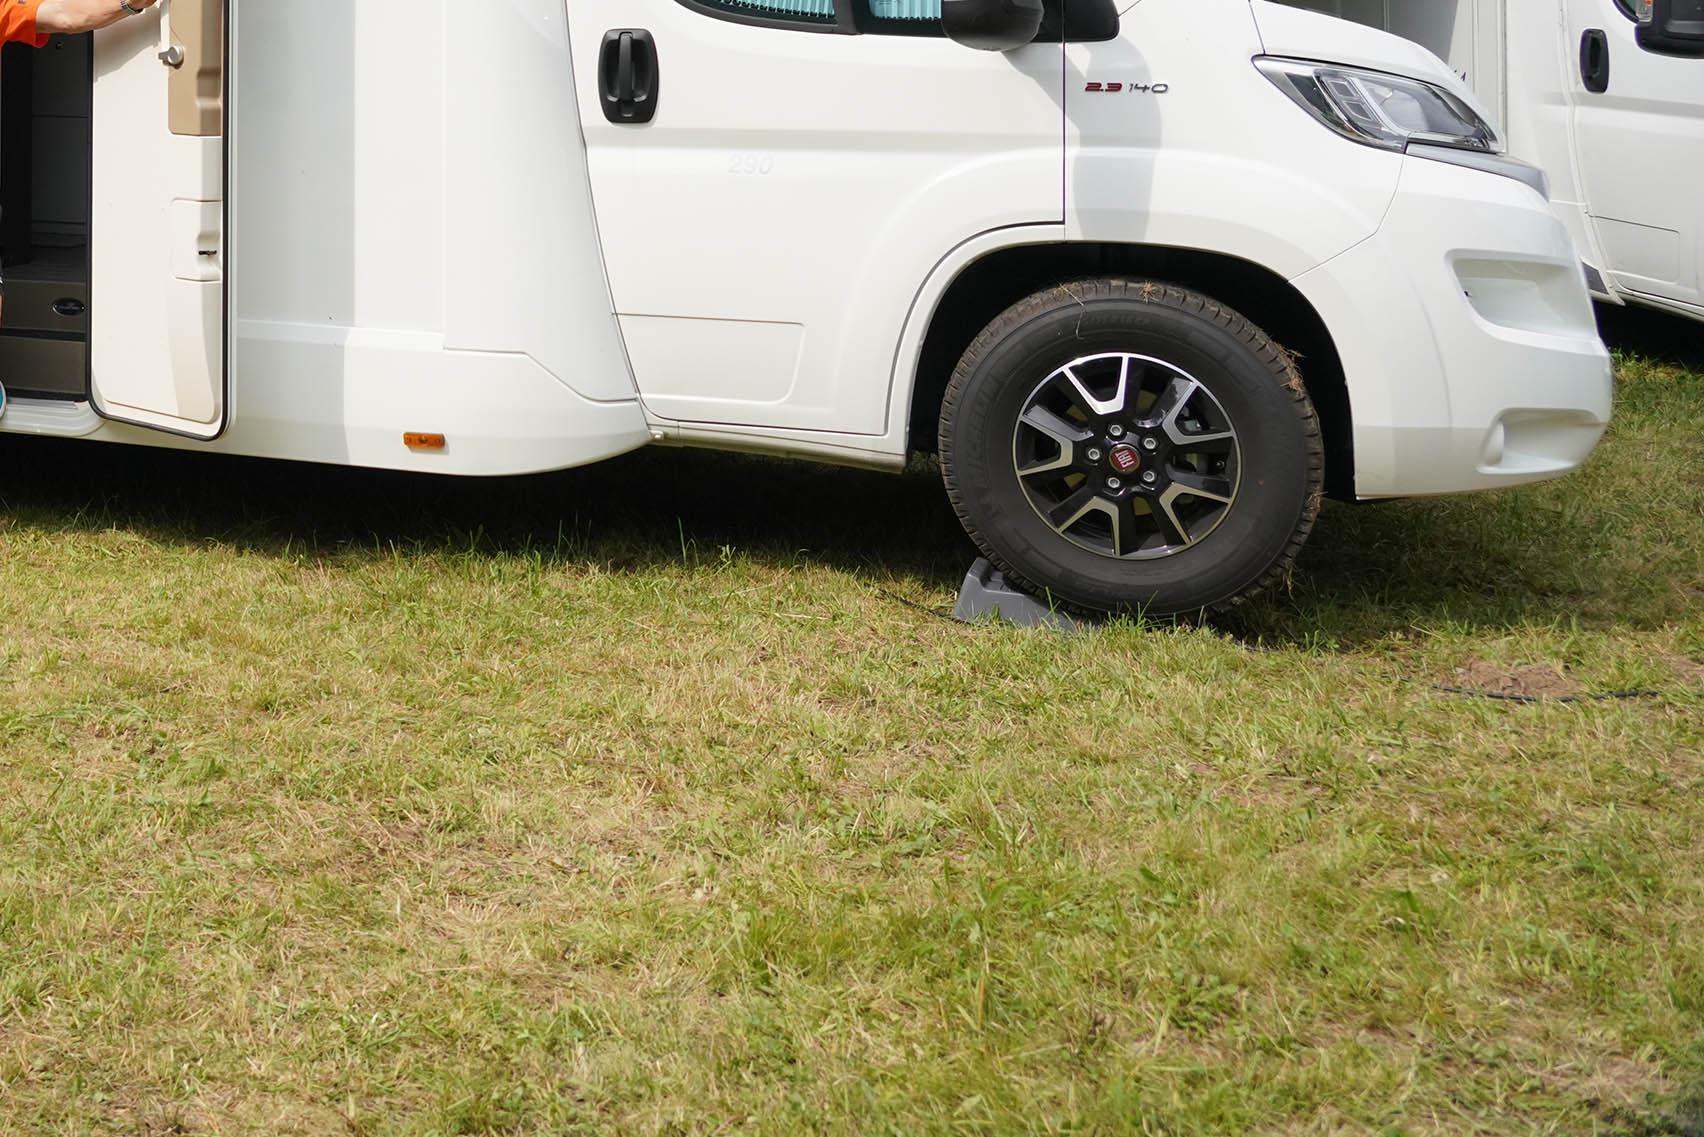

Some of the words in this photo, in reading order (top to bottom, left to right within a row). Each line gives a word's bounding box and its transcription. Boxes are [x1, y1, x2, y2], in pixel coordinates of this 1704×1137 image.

[1085, 82, 1123, 93] 2.3
[1129, 83, 1169, 93] 140
[1114, 449, 1135, 468] FIAT
